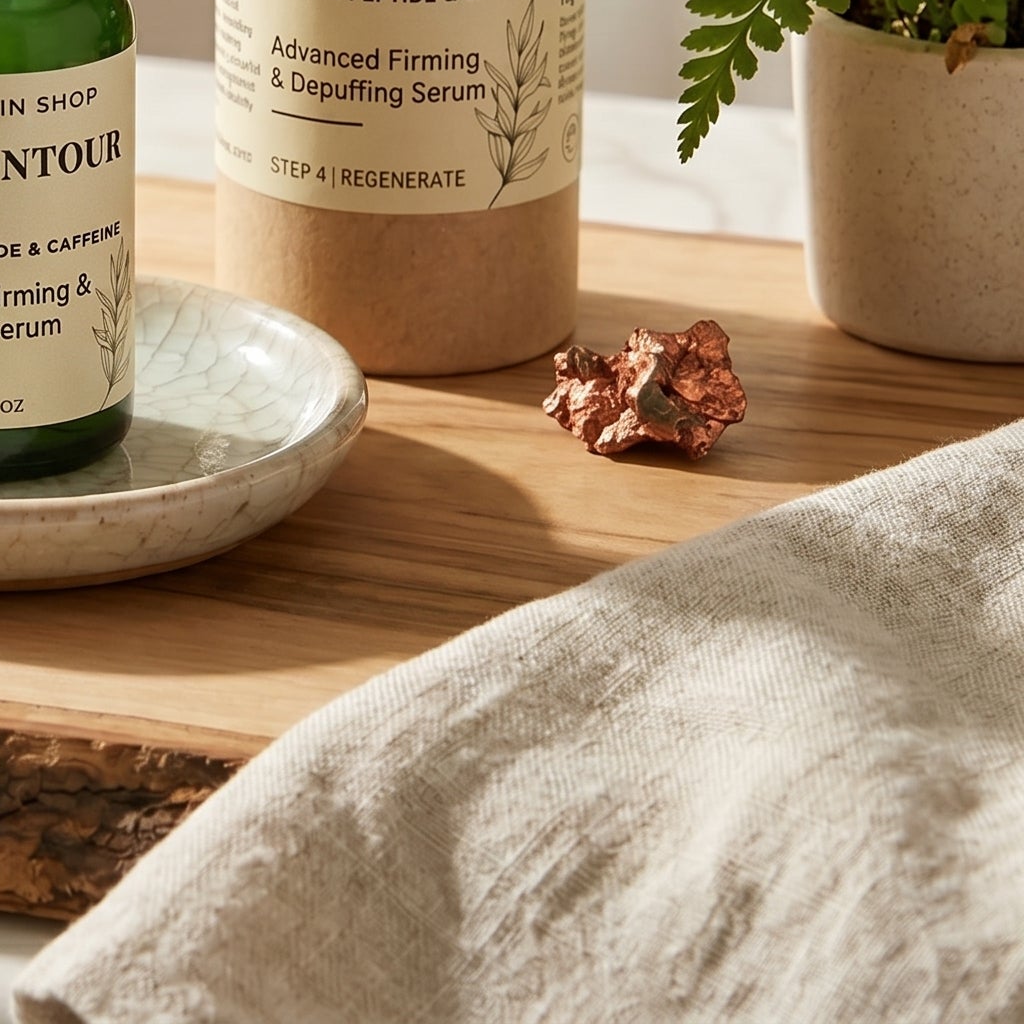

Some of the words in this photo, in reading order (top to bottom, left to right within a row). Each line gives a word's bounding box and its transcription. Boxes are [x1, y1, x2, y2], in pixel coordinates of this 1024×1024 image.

[272, 36, 379, 72] Advanced
[390, 48, 479, 74] Firming
[37, 87, 97, 113] SHOP
[272, 67, 284, 89] &
[292, 72, 402, 108] Depuffing
[412, 82, 485, 103] Serum
[272, 157, 311, 179] STEP
[316, 167, 326, 182] 4
[342, 169, 465, 188] REGENERATE
[28, 242, 40, 256] &
[47, 221, 121, 254] CAFFEINE
[77, 273, 91, 296] &
[0, 399, 23, 413] OZ
